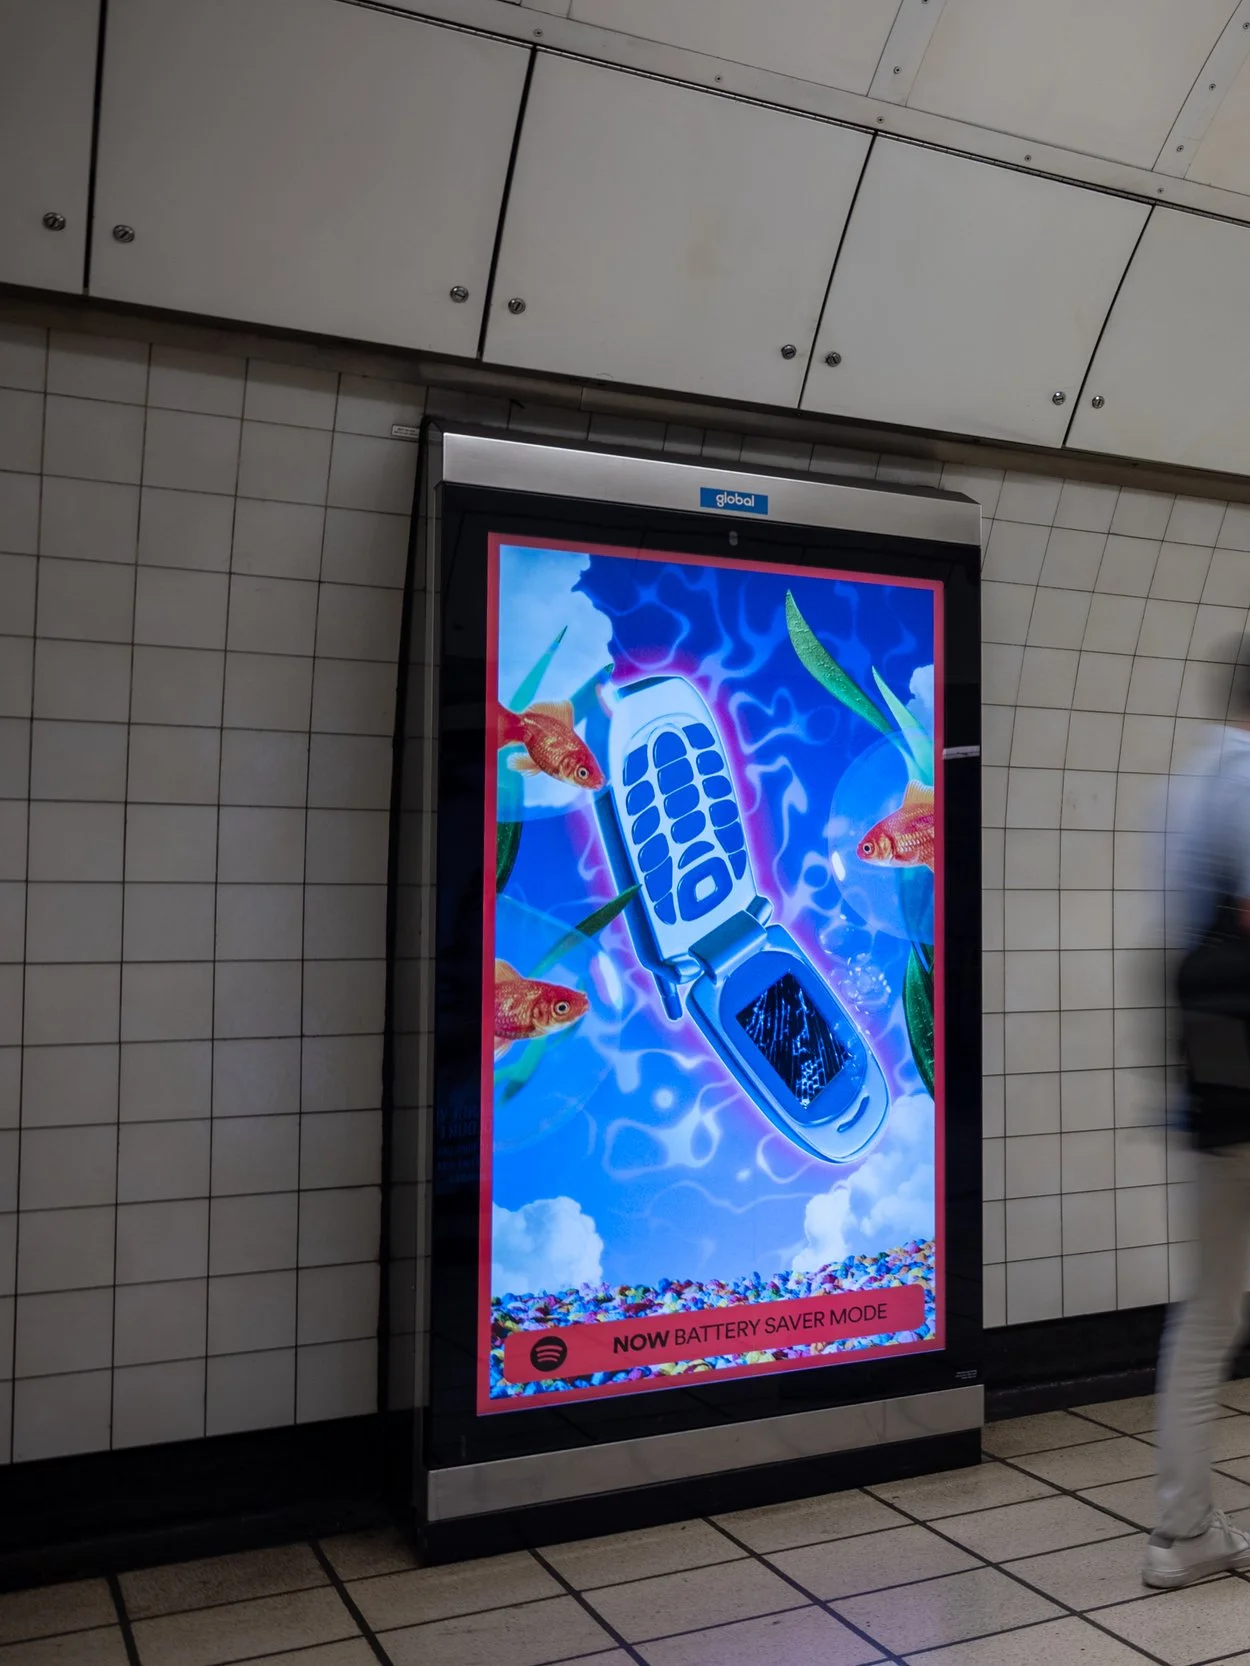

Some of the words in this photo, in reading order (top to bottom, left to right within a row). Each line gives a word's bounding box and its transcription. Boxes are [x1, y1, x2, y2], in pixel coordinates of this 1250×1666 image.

[716, 491, 754, 507] global
[613, 1330, 670, 1353] NOW
[674, 1319, 761, 1346] BATTERY
[764, 1310, 825, 1334] SAVER
[829, 1303, 888, 1327] MODE
